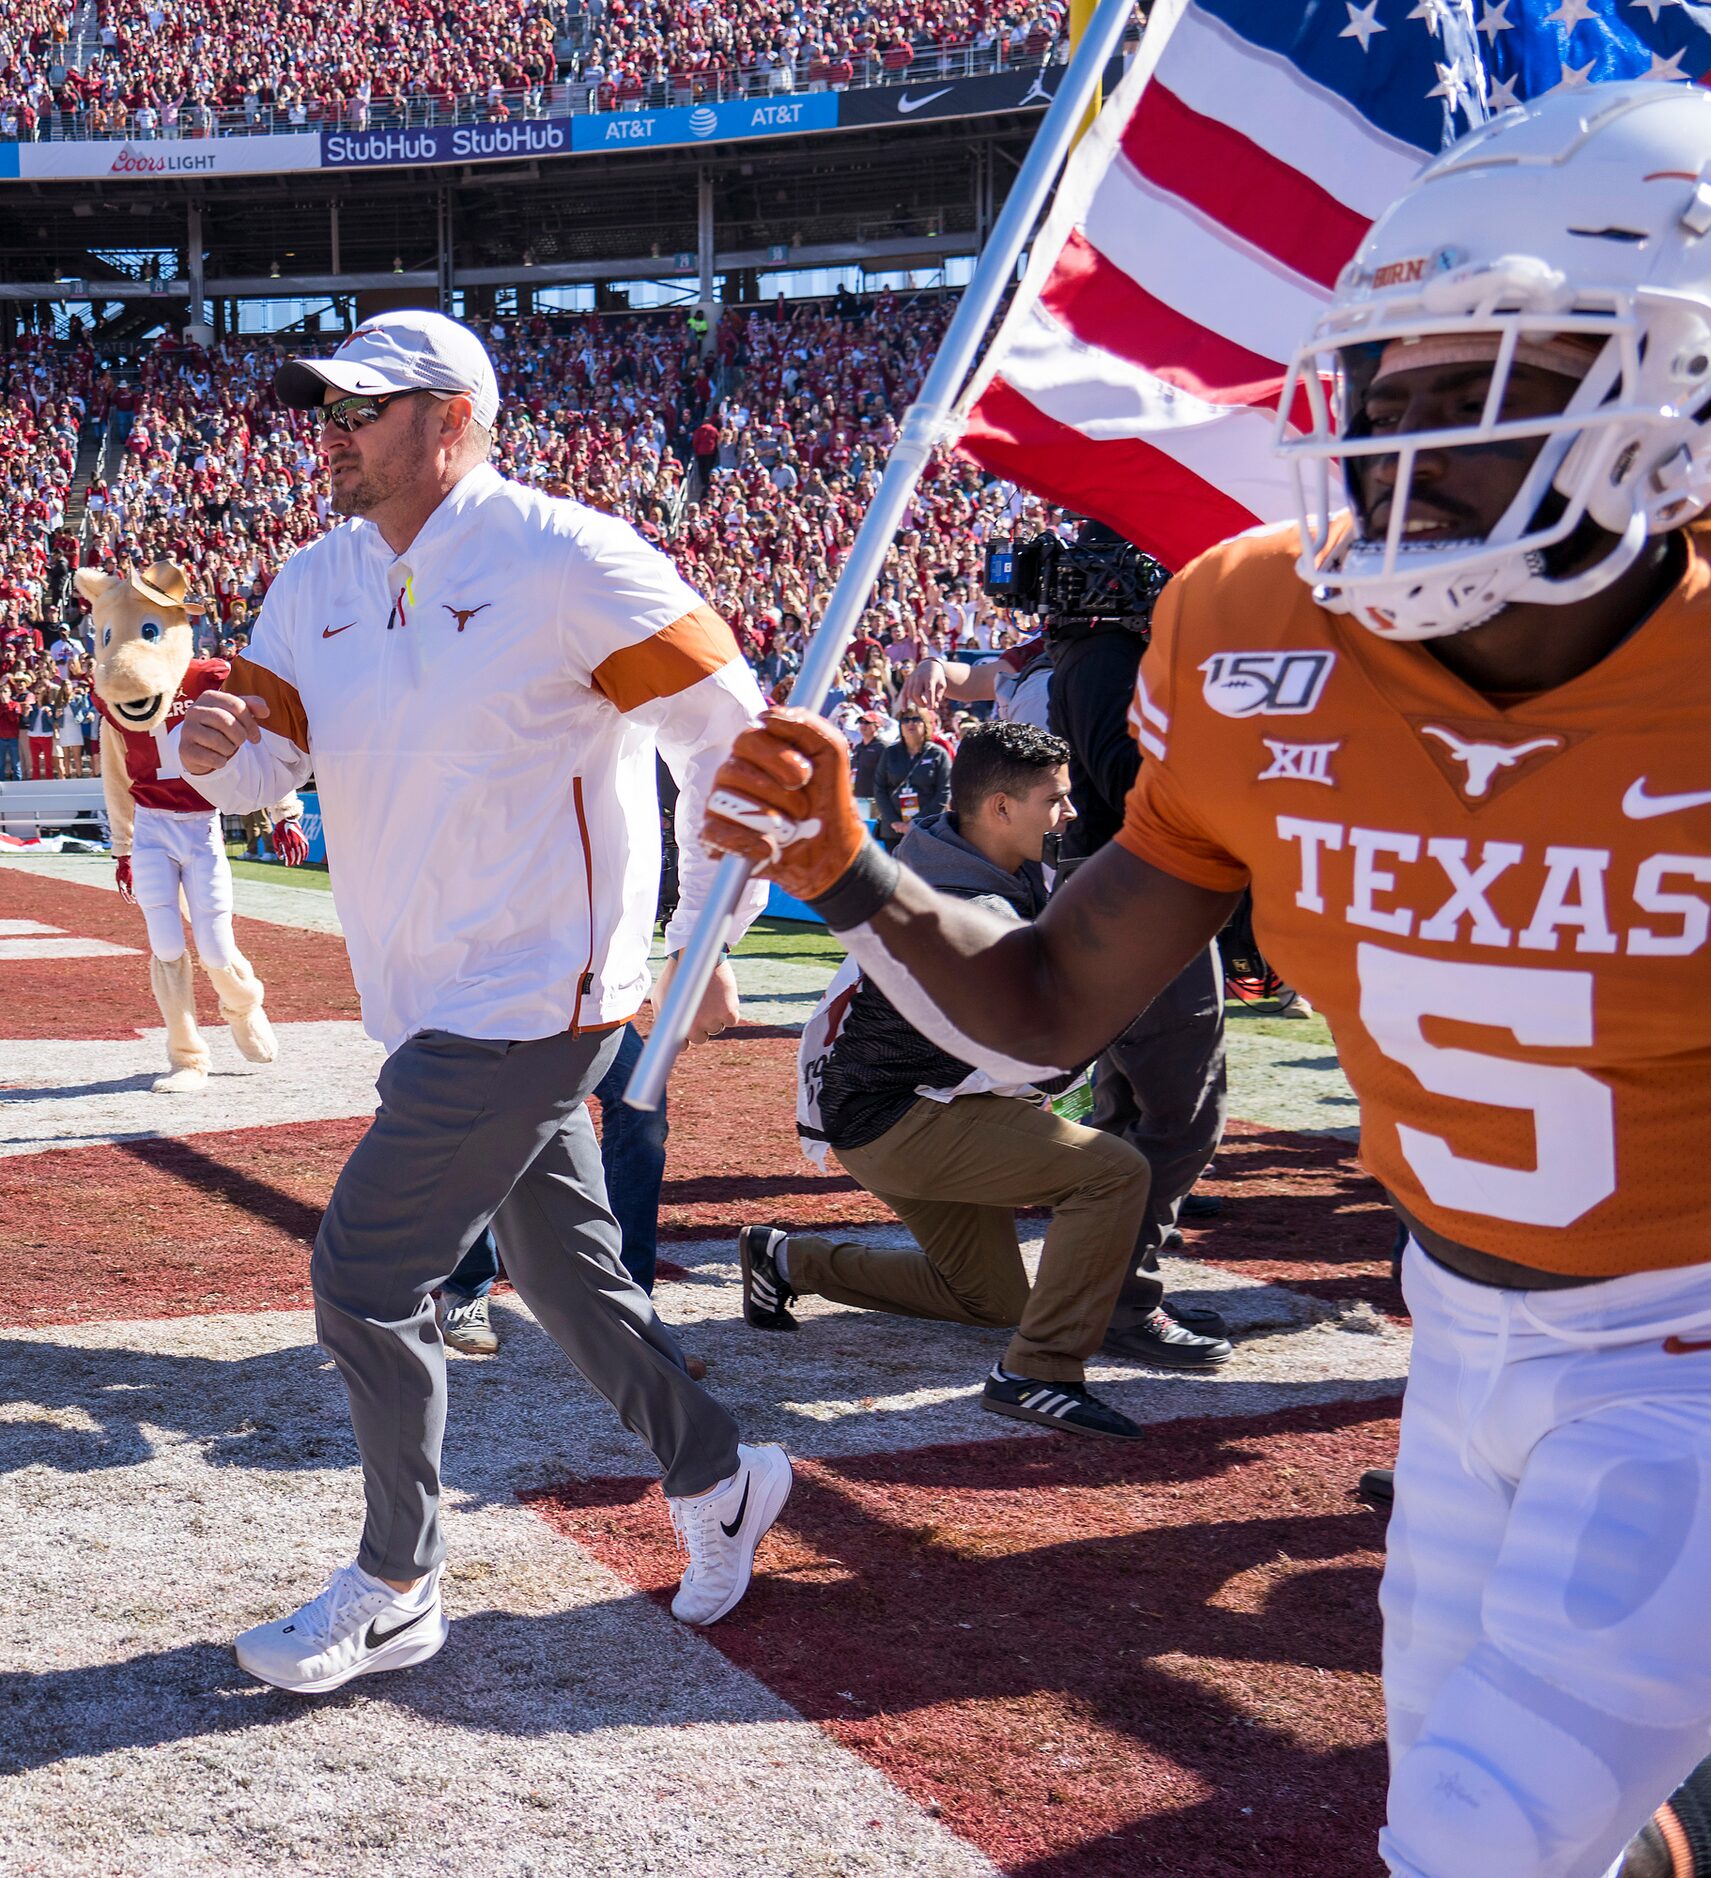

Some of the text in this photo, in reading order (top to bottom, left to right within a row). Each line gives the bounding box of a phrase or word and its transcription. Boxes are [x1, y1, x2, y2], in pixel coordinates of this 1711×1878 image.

[327, 124, 563, 161] StubHub StubHub
[605, 104, 803, 140] AT&T AT&T
[112, 150, 216, 171] Coors LIGHT
[1204, 654, 1334, 717] 150
[1258, 739, 1340, 786] XII
[1276, 815, 1711, 956] TEXAS
[1357, 942, 1616, 1229] 5
